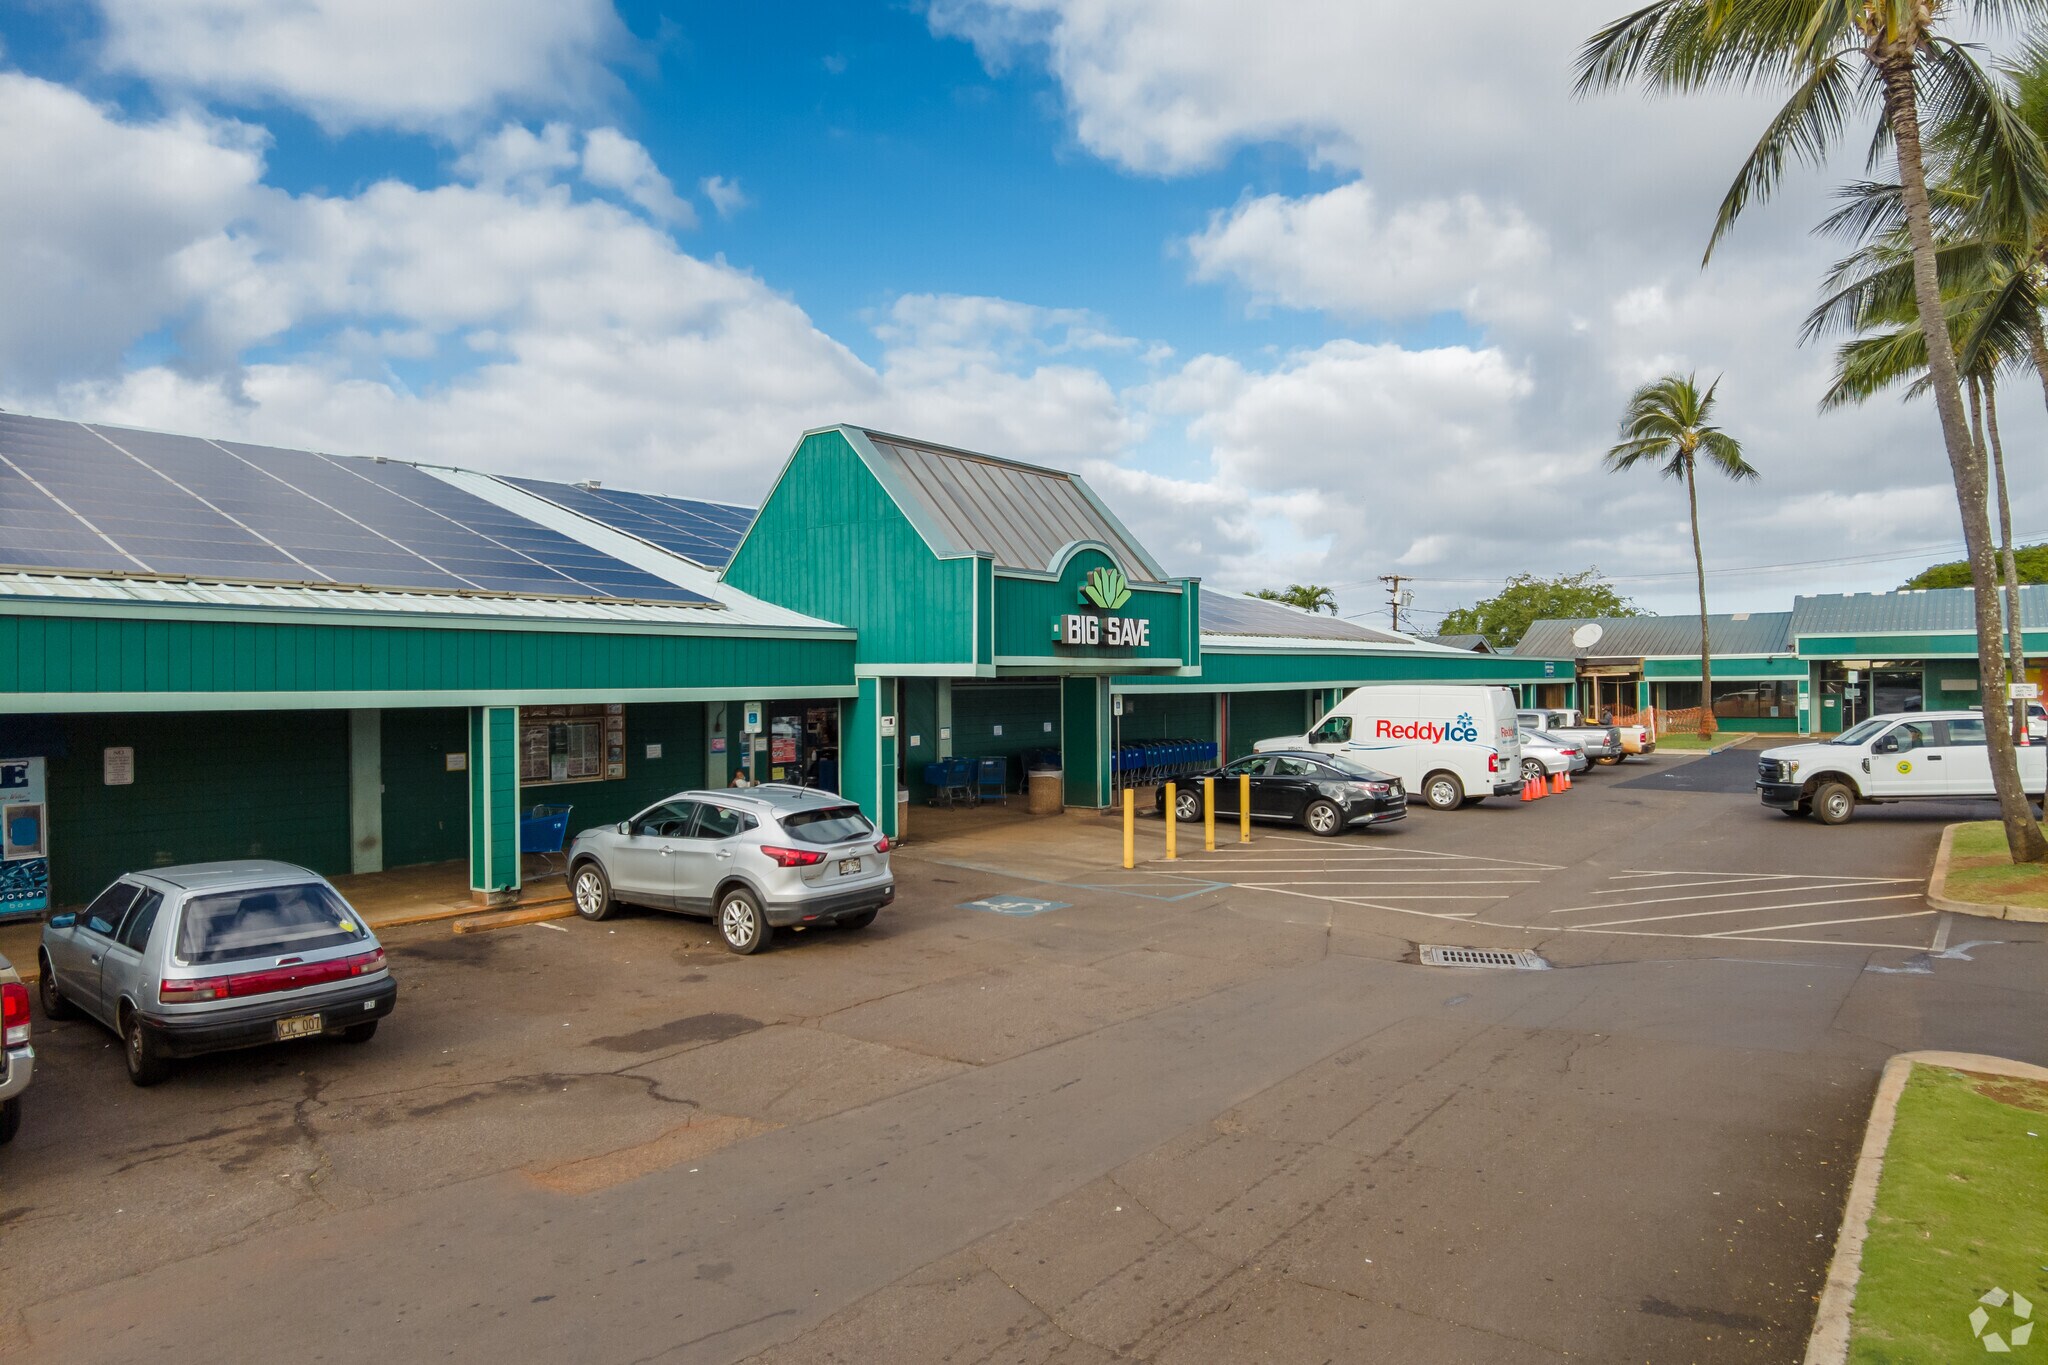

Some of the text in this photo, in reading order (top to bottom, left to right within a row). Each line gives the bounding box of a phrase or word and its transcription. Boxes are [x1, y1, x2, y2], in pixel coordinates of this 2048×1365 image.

[1066, 614, 1150, 647] BIG SAVE
[1376, 719, 1478, 744] ReddyIce
[279, 1017, 320, 1036] KJC 007
